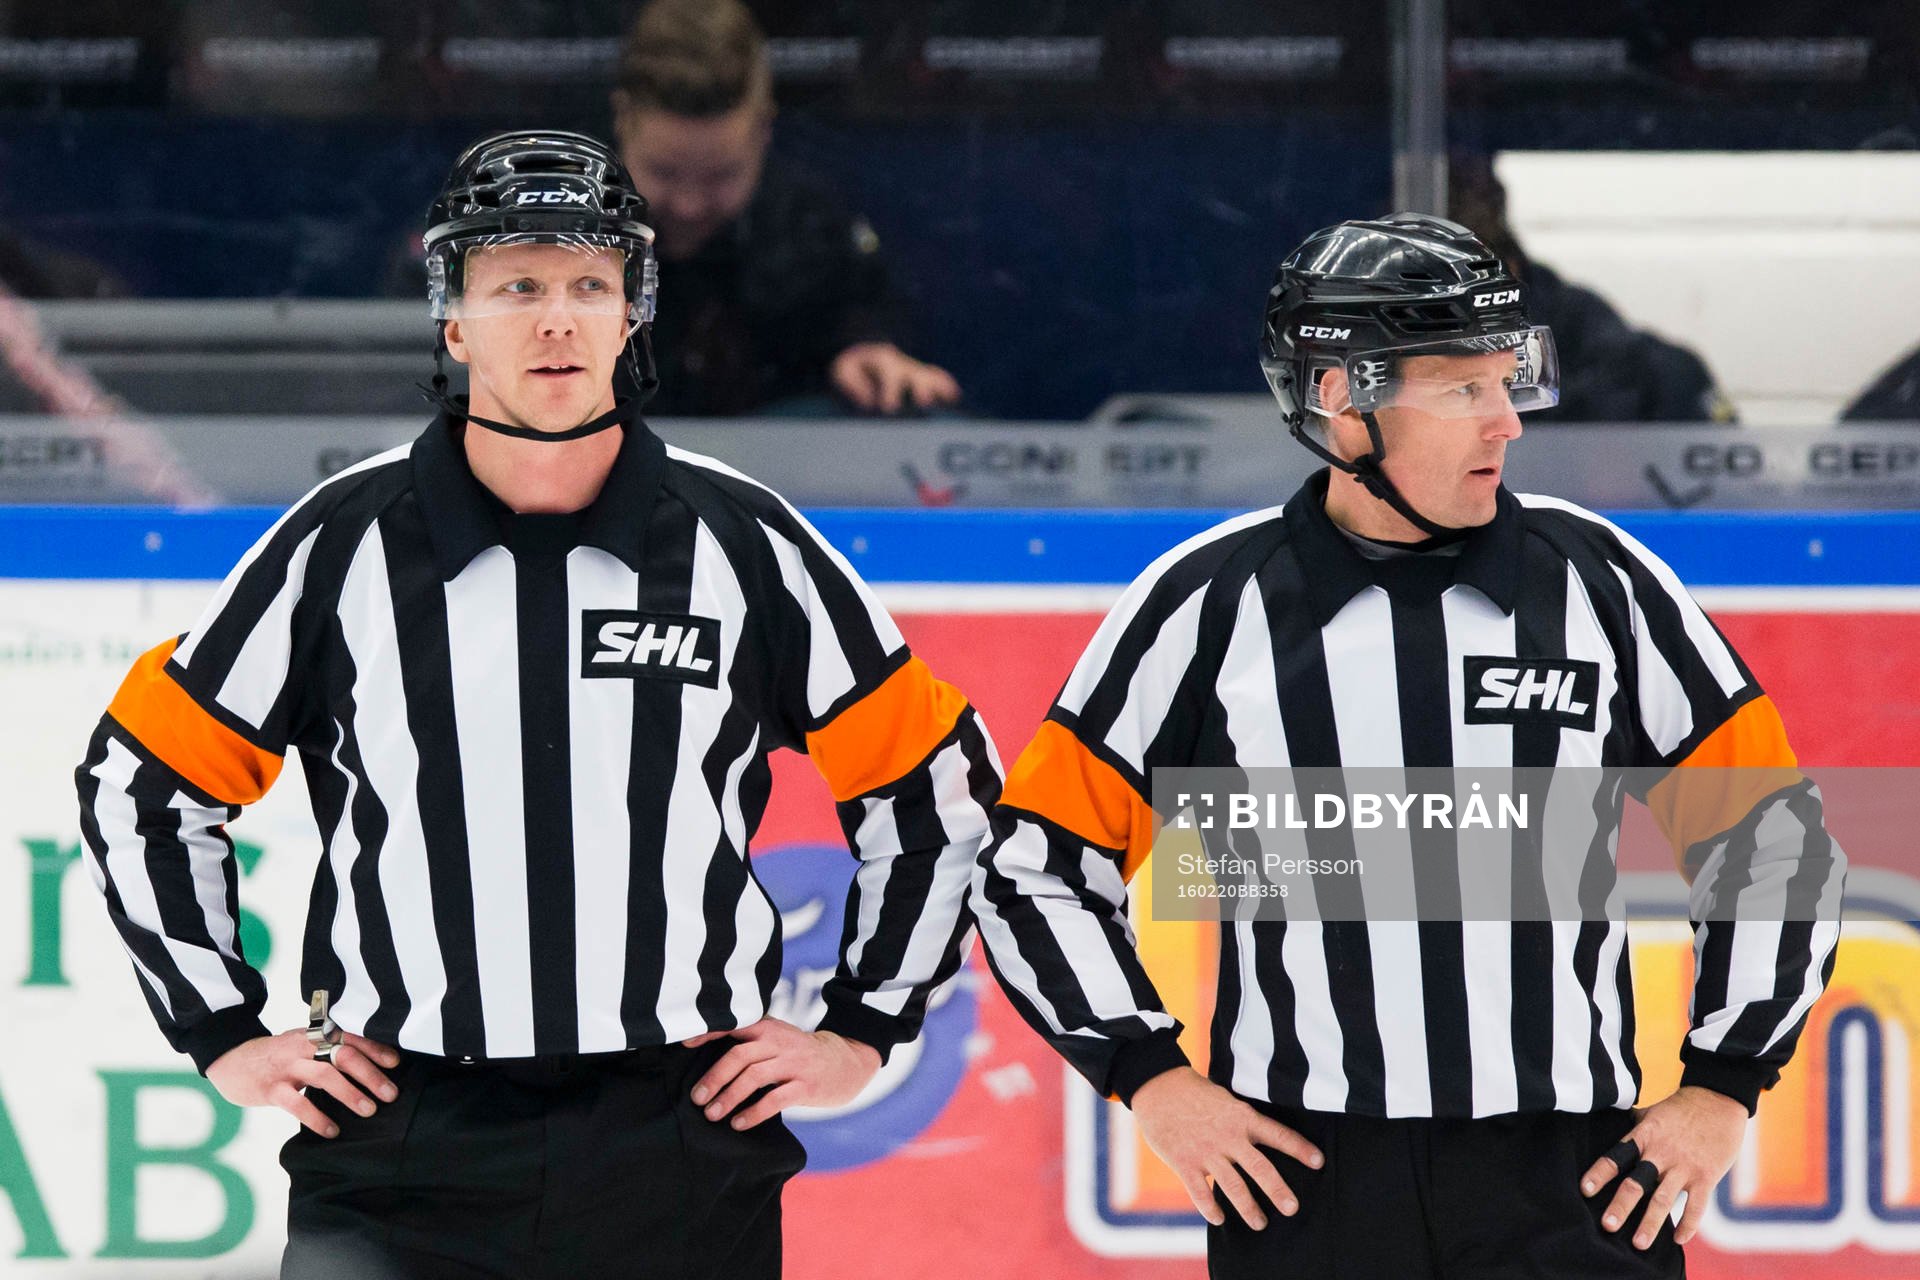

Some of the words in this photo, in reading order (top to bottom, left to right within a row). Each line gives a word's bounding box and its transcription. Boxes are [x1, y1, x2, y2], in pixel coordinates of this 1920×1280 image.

[517, 190, 590, 206] CCM
[1473, 288, 1520, 308] CCM
[1299, 325, 1351, 341] CCM
[591, 621, 713, 672] SHL
[1474, 667, 1589, 715] SHL
